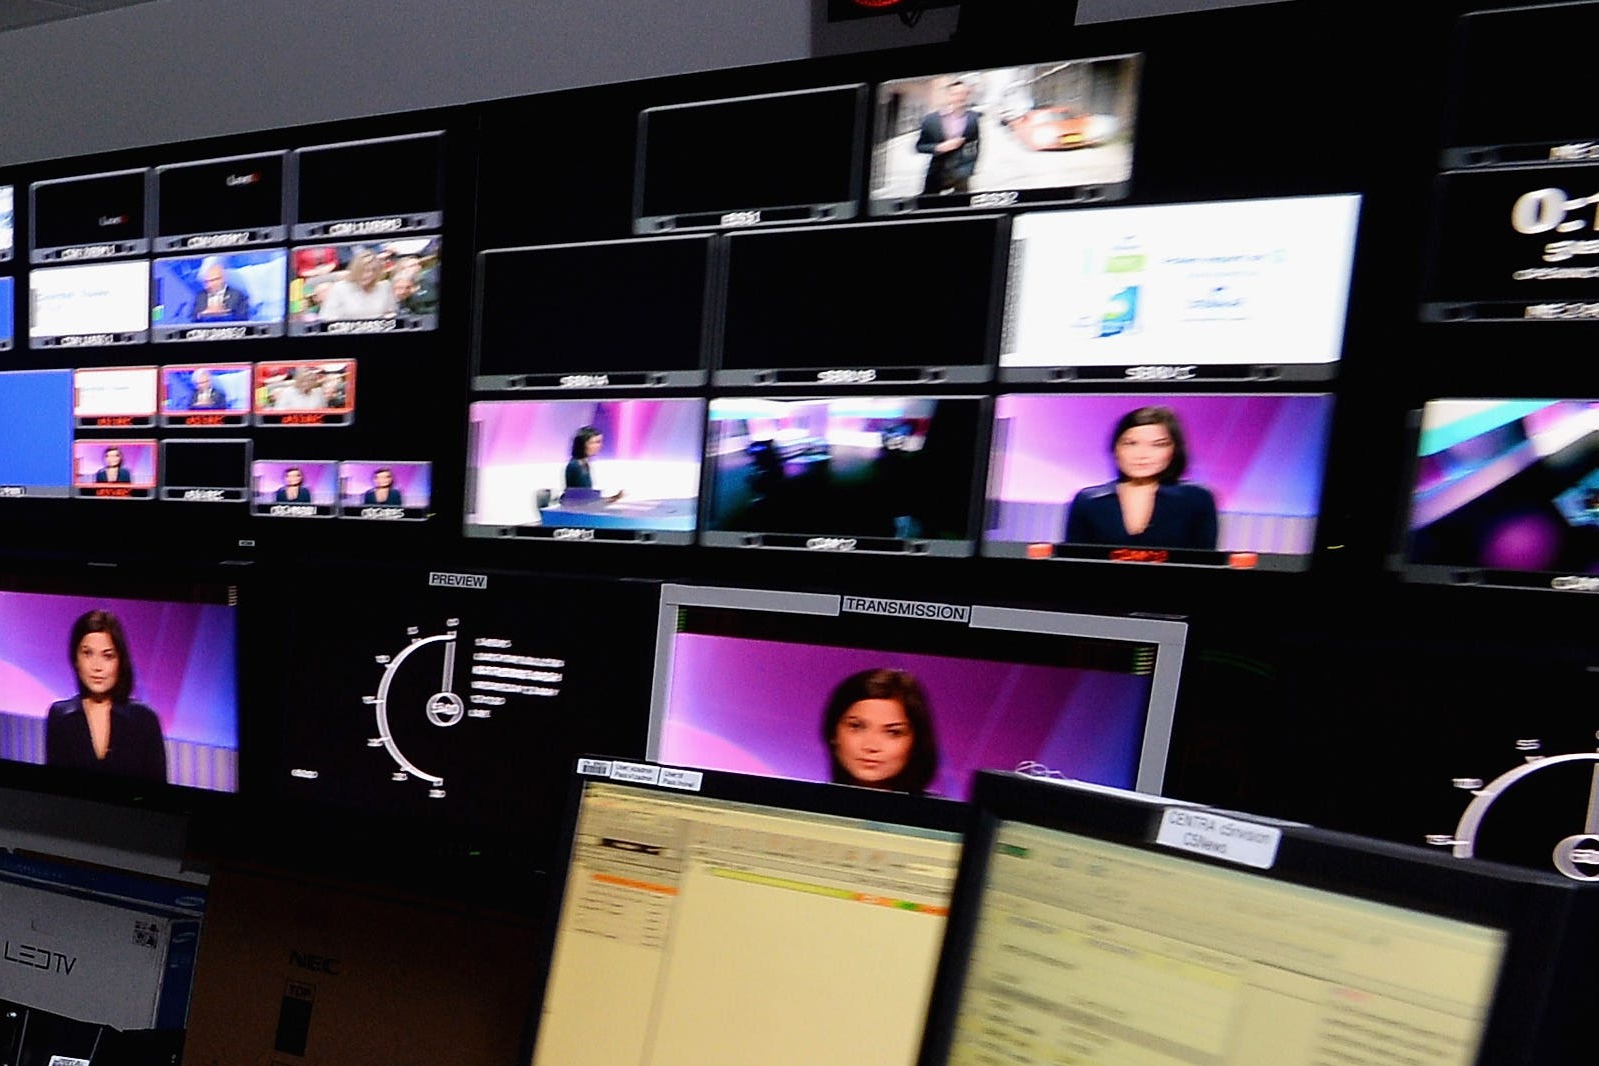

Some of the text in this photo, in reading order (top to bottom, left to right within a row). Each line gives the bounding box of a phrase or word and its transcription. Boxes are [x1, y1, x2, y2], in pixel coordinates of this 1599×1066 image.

[430, 573, 486, 588] PREVIEW
[846, 598, 965, 621] TRANSMISSION
[289, 950, 341, 976] NEC
